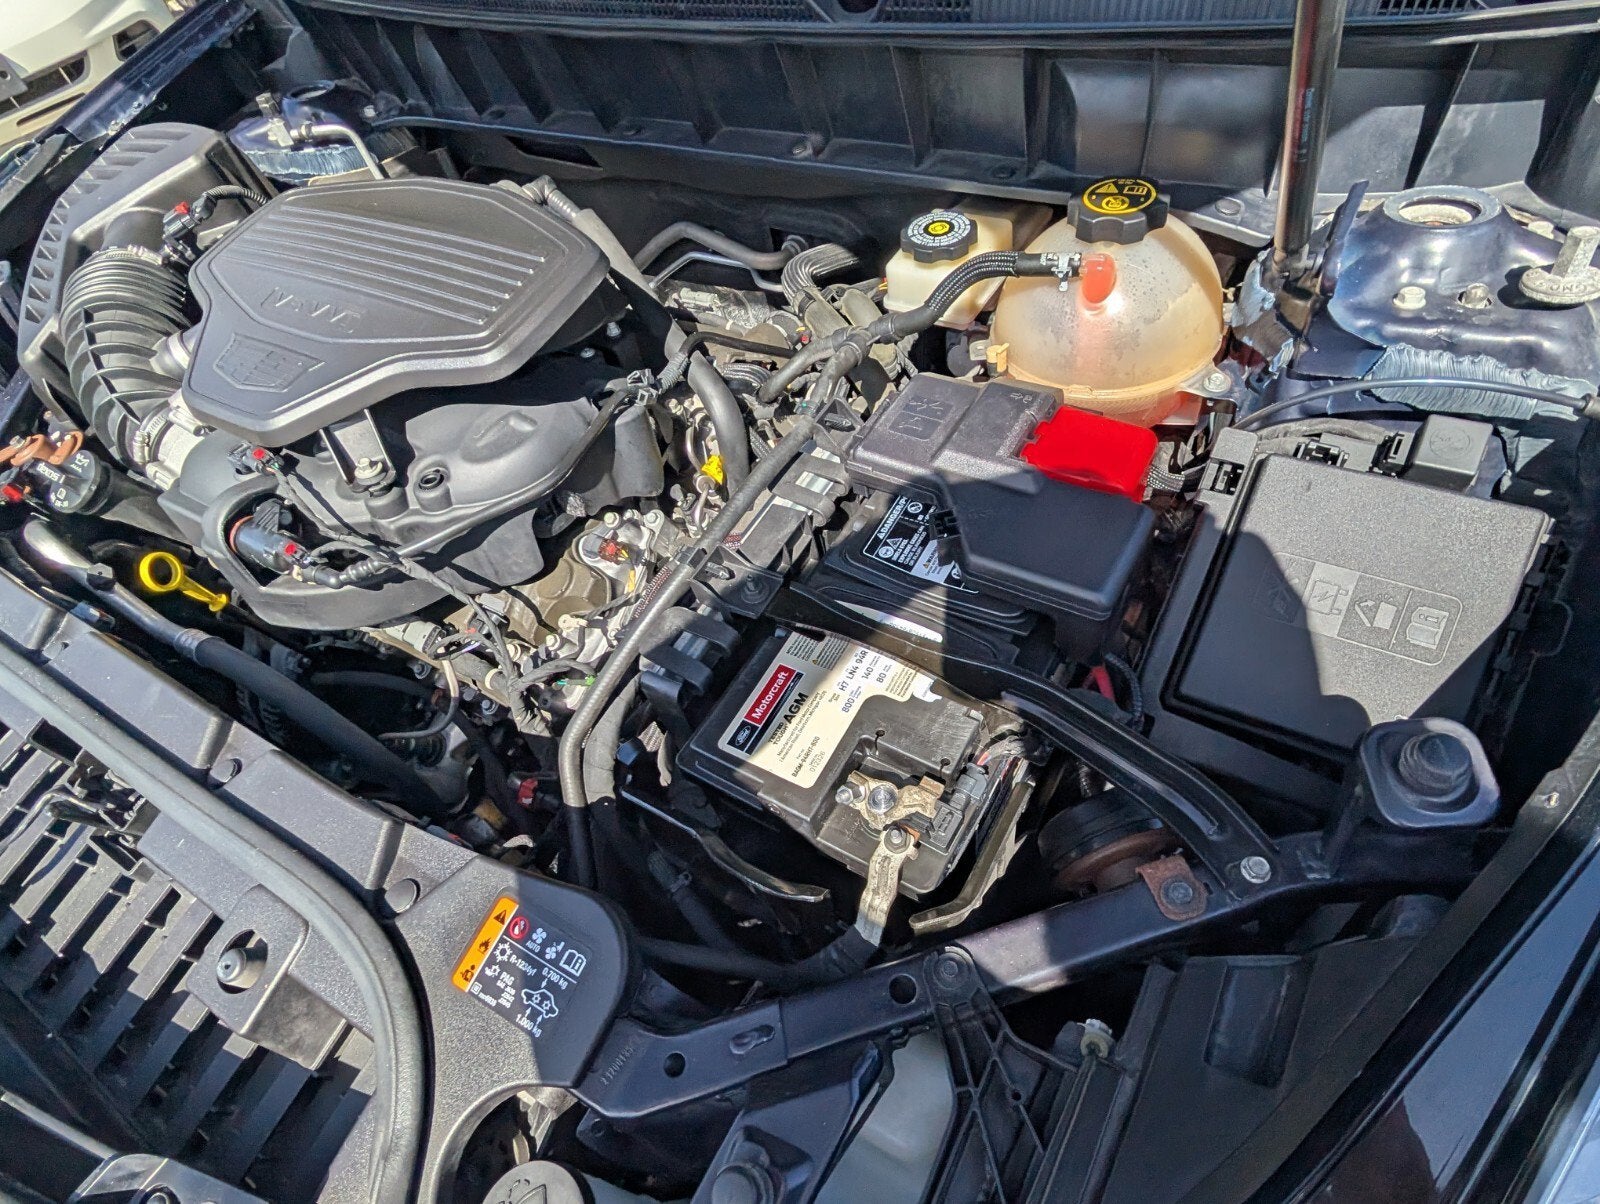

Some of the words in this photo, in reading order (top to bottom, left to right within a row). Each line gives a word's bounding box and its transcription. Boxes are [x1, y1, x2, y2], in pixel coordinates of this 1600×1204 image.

[838, 680, 849, 691] H7
[846, 664, 859, 680] LN4
[854, 649, 868, 665] 94R
[861, 665, 874, 680] 140
[875, 671, 886, 683] 80
[751, 669, 788, 719] Motorcraft
[841, 696, 855, 713] 800
[767, 721, 784, 743] TESTED
[782, 690, 808, 724] AGM
[525, 939, 541, 953] AUTO
[498, 971, 515, 986] PAG
[556, 977, 569, 990] kg
[529, 1024, 543, 1038] kg
